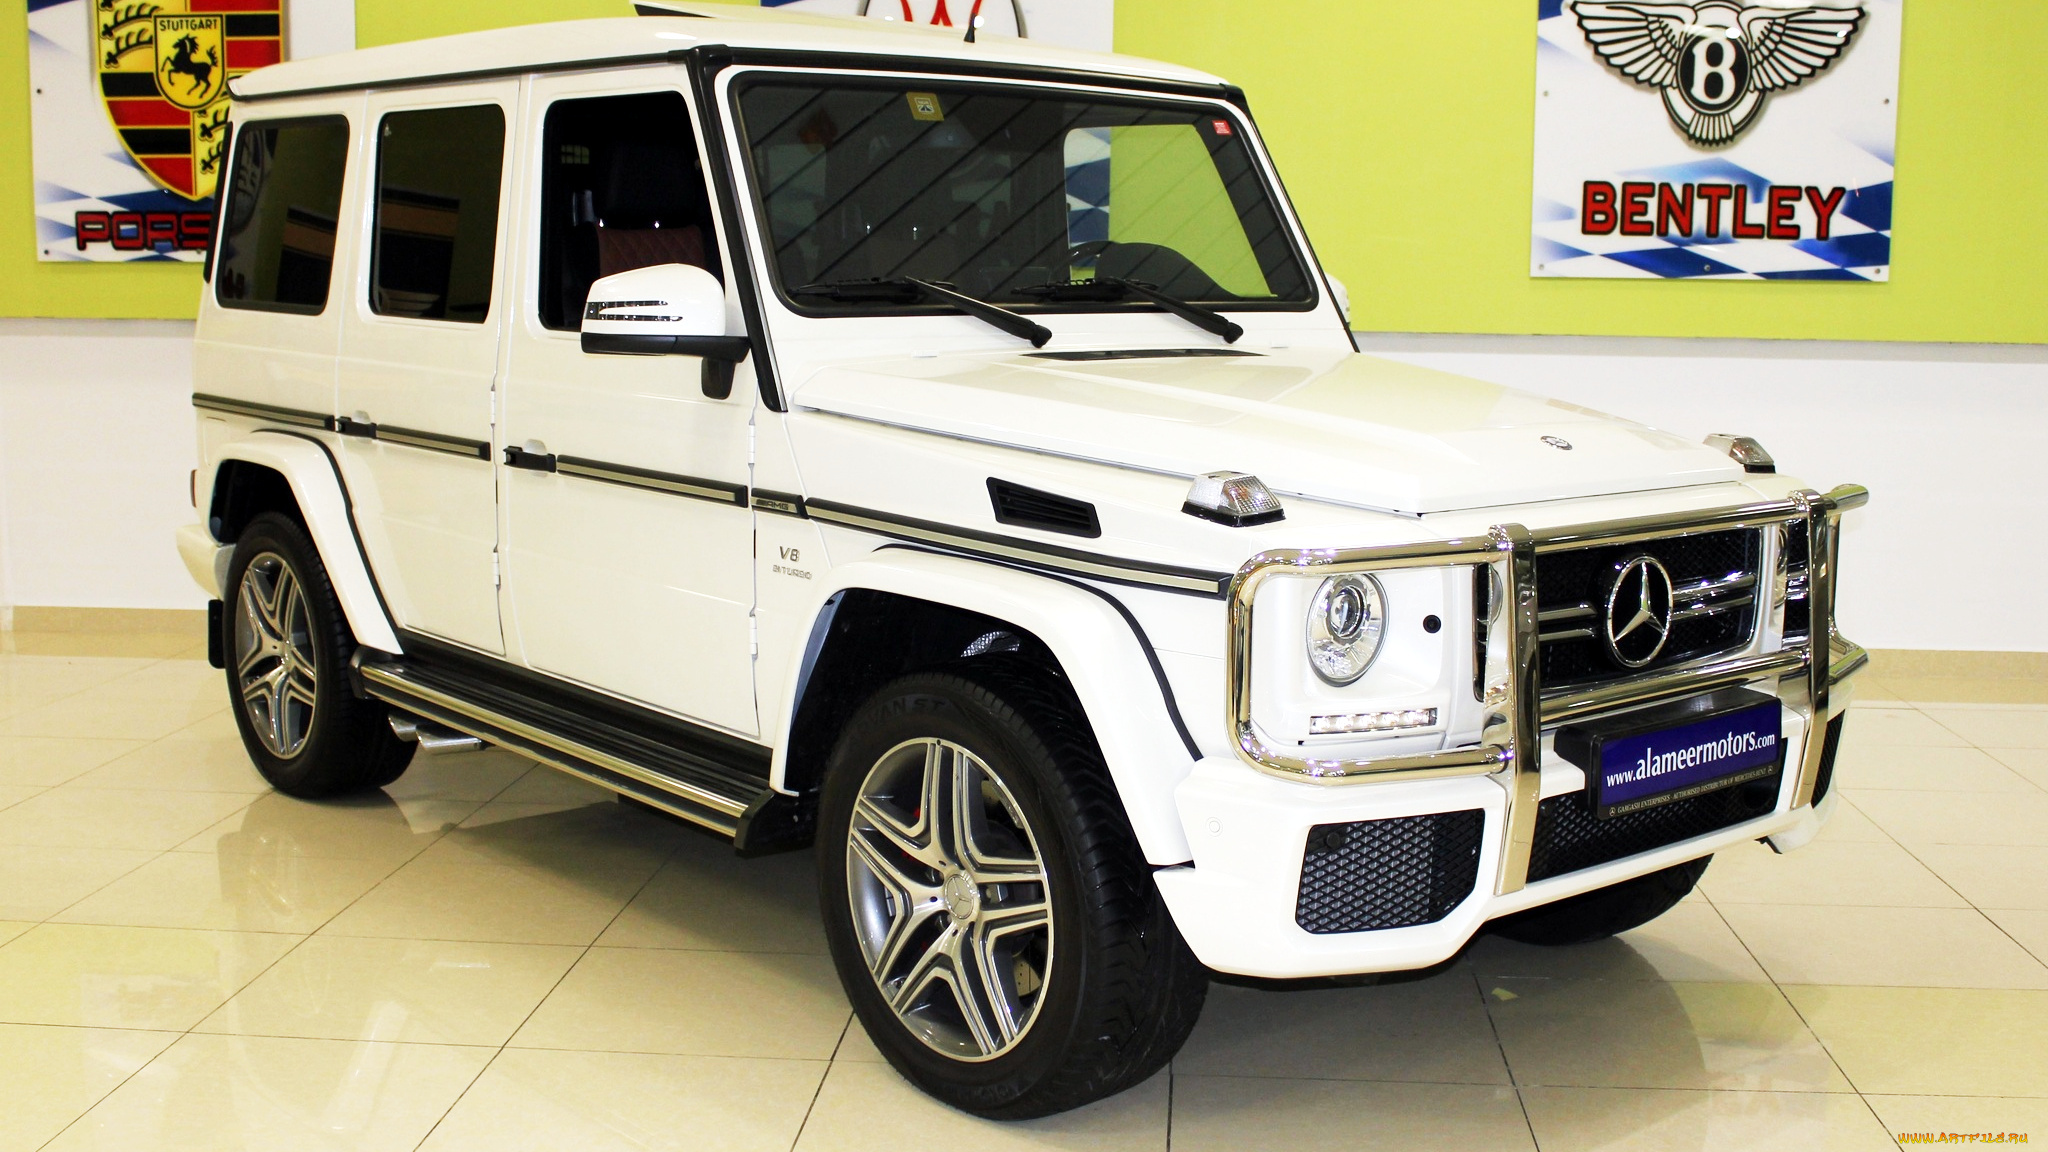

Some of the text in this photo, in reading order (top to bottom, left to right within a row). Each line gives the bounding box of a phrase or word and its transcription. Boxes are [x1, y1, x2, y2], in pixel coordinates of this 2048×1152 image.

[159, 18, 217, 32] STUTTGART
[1692, 39, 1737, 105] B
[1581, 180, 1847, 241] BENTLEY
[765, 498, 789, 511] AMG
[779, 545, 801, 562] V8
[1606, 731, 1776, 787] www.alameermotors.com
